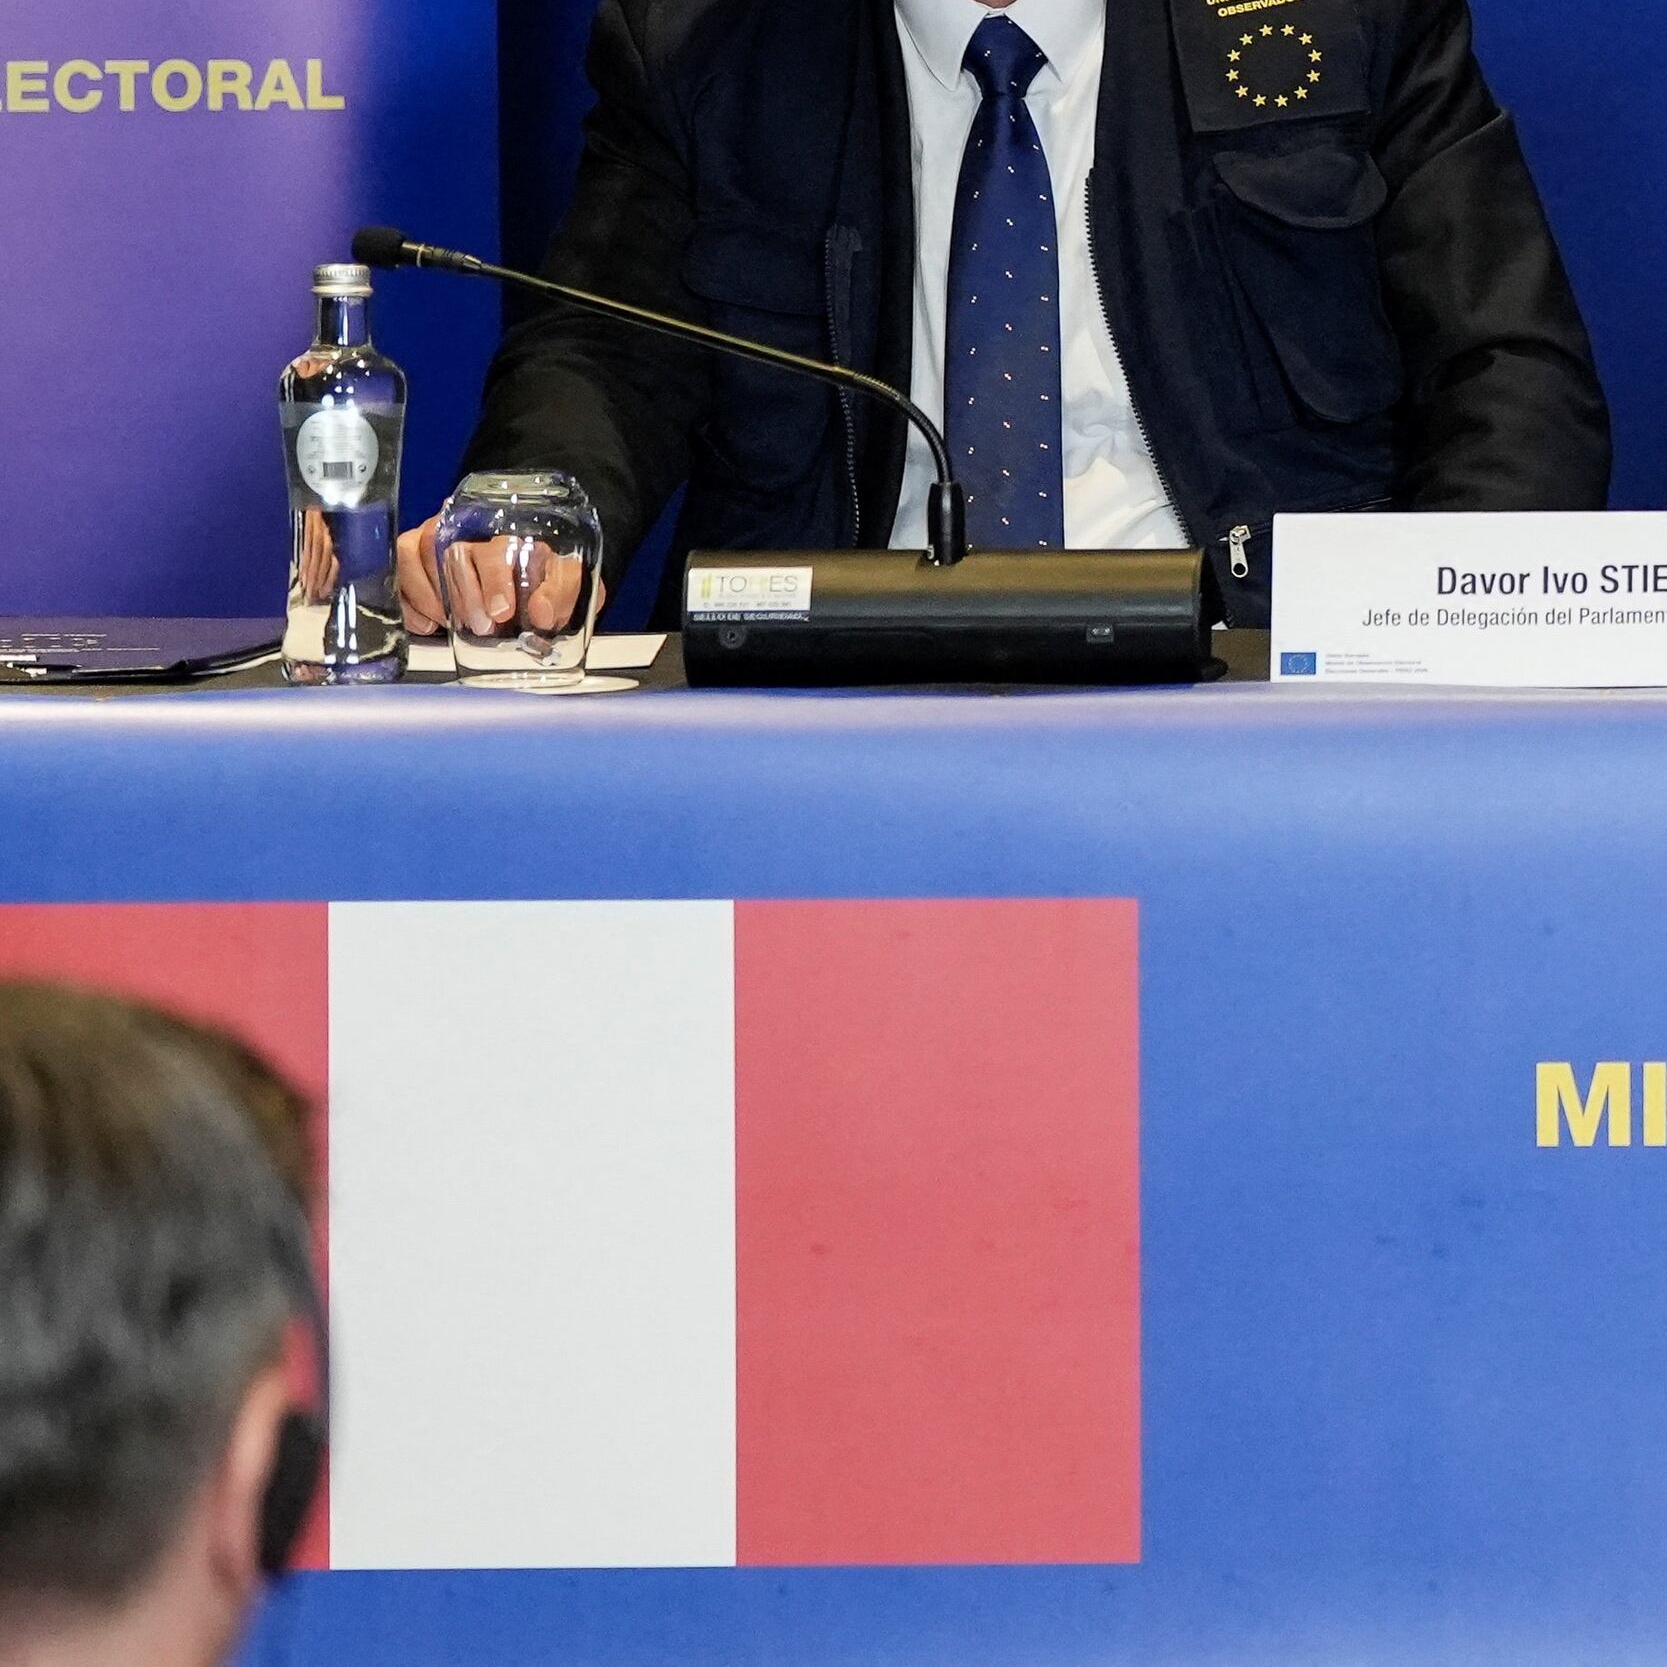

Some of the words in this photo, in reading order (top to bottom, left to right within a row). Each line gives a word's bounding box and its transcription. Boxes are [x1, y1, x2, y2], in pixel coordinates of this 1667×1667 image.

[1437, 566, 1531, 596] Davor
[1542, 565, 1588, 595] Ivo
[1362, 608, 1401, 627] Jefe
[1408, 608, 1430, 626] de
[1437, 607, 1538, 630] Delegación
[1545, 607, 1572, 626] del
